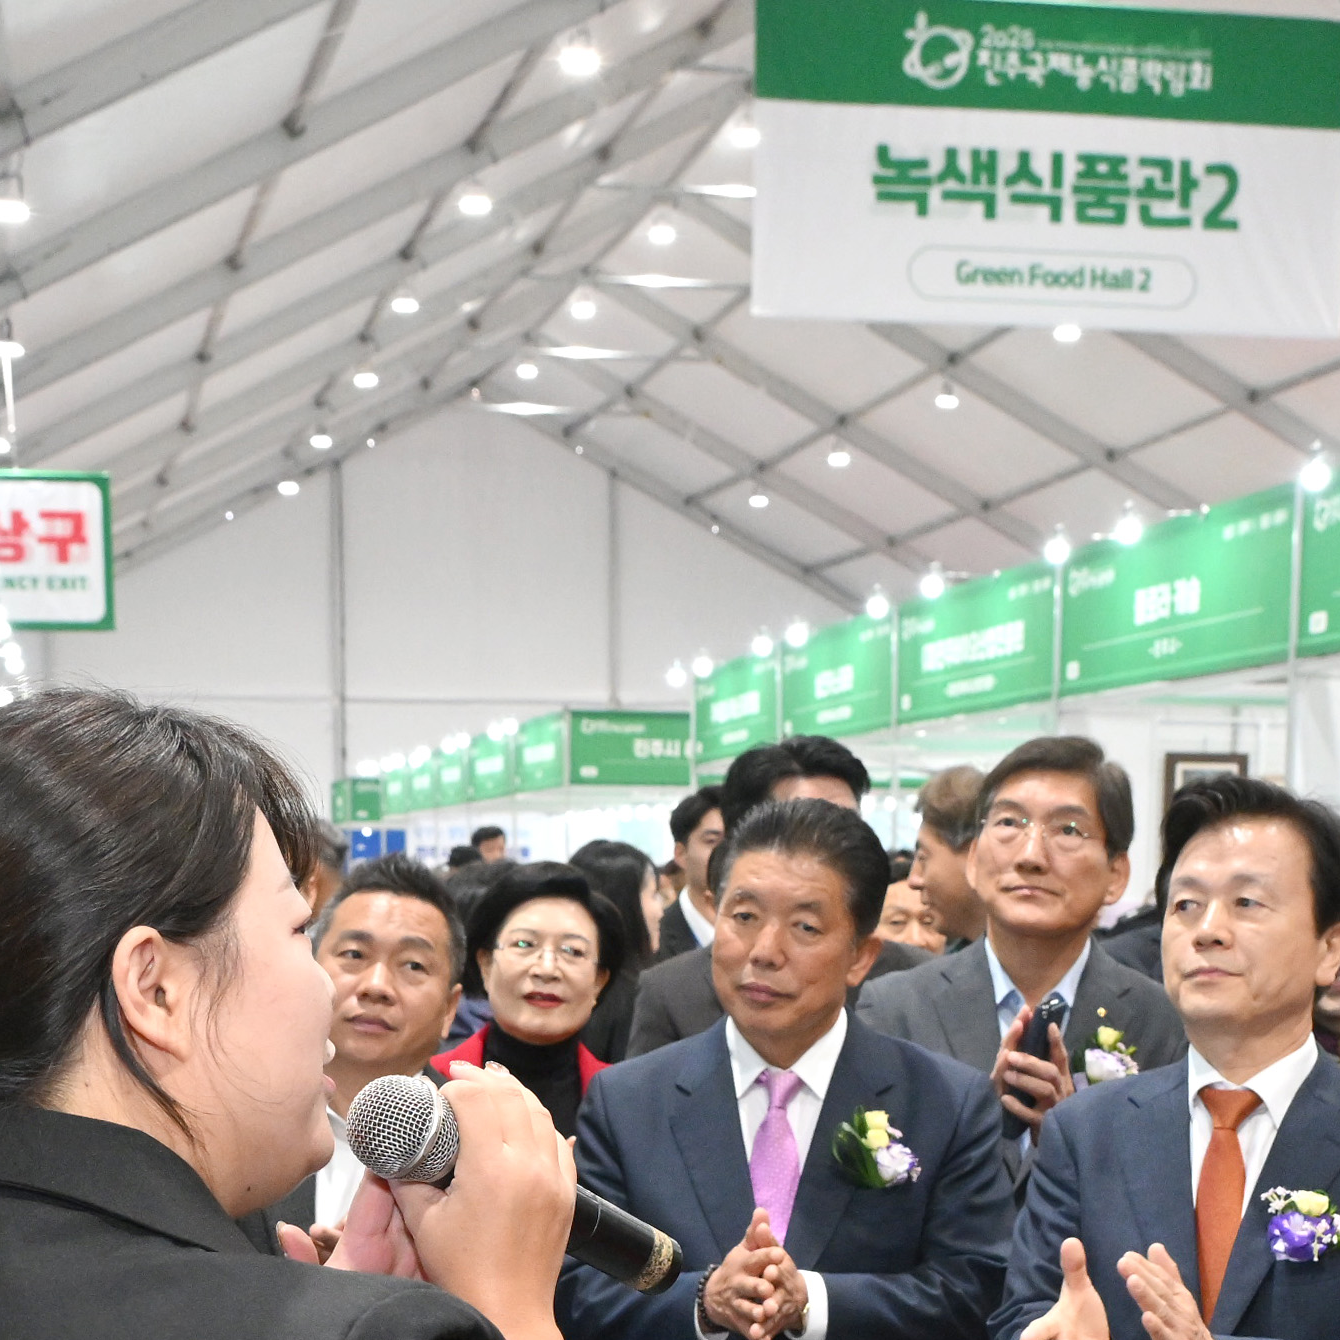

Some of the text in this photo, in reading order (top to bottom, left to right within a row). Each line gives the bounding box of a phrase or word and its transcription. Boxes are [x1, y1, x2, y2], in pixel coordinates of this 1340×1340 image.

[872, 144, 1239, 230] 녹색식품관2
[955, 259, 1152, 292] Green Food Hall 2
